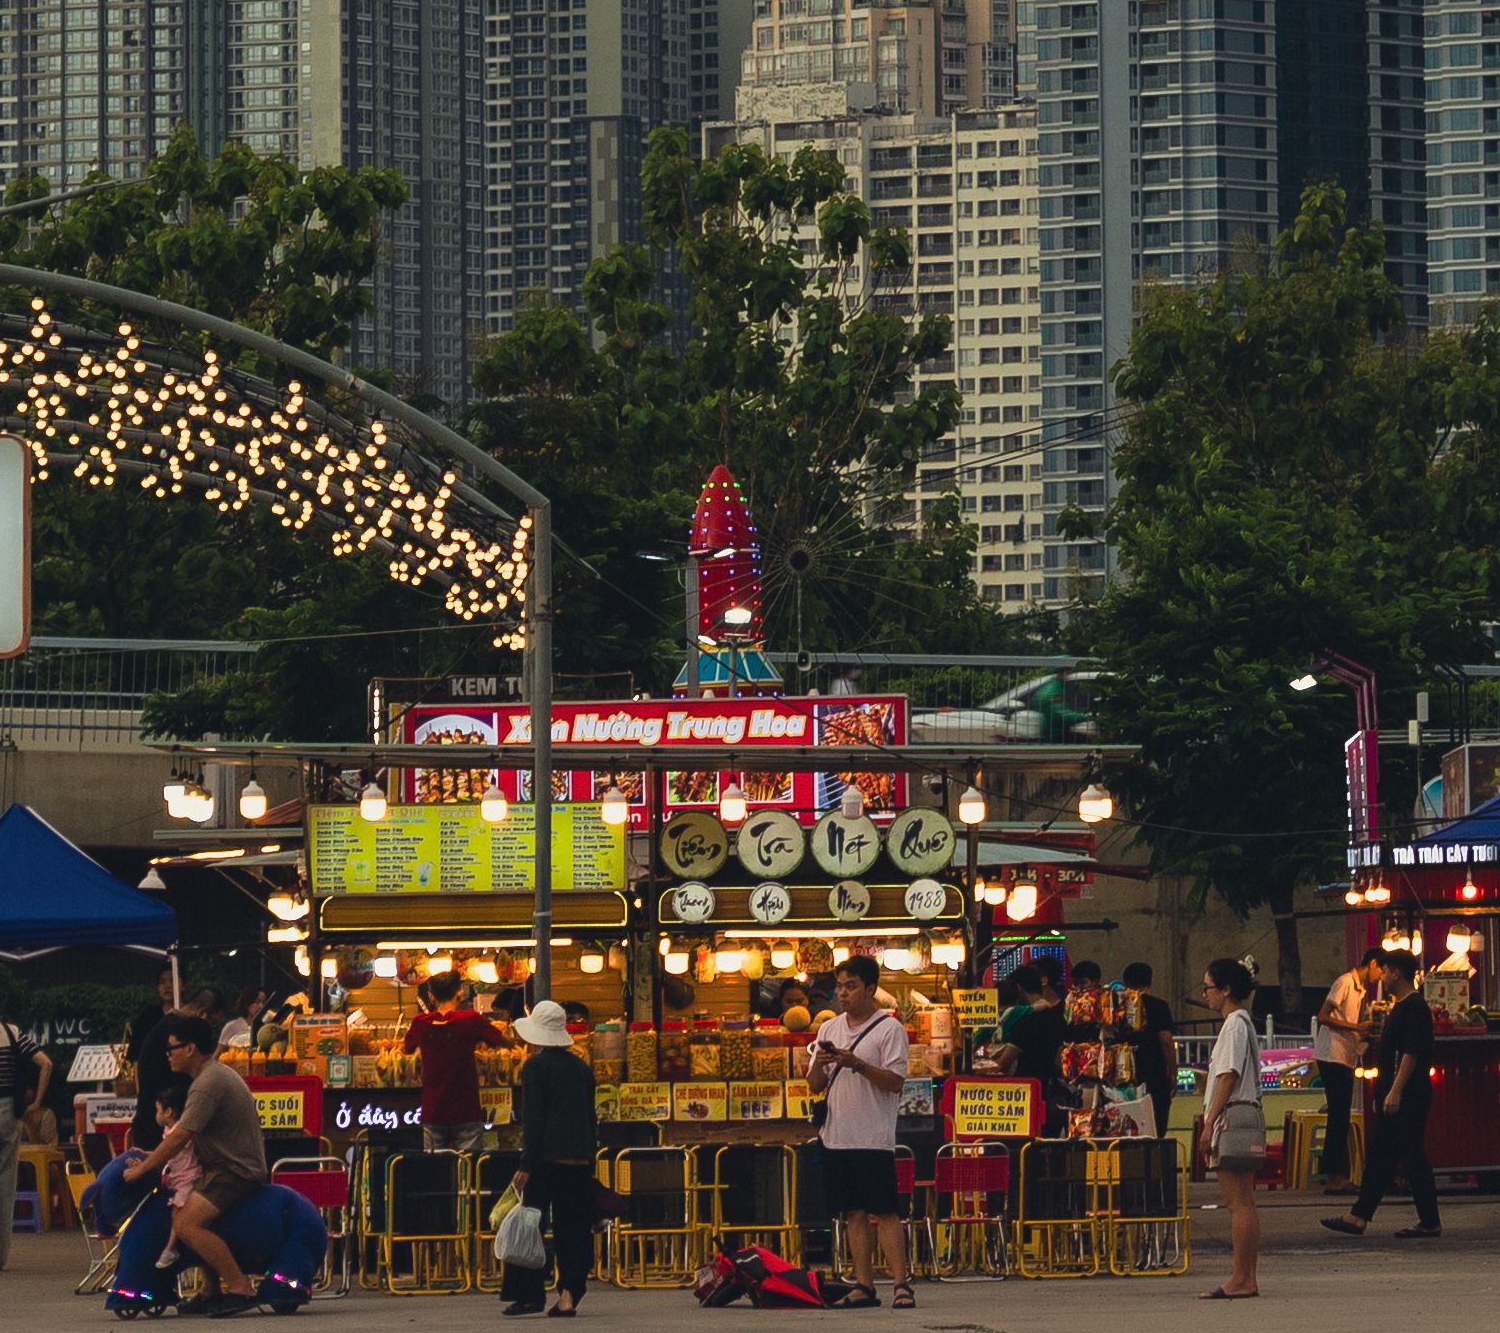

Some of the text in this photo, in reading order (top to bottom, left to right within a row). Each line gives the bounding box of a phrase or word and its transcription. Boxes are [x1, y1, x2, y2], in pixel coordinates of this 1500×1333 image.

[452, 677, 497, 696] KEM
[666, 709, 747, 745] Trung
[748, 709, 807, 738] Hoa
[900, 818, 949, 861] Quê
[1393, 844, 1414, 865] TRÀ
[1418, 843, 1444, 864] TRÁI
[1447, 843, 1468, 863] CÂY
[908, 890, 943, 912] 1988
[54, 1017, 92, 1035] WC
[269, 1094, 299, 1111] SUỐI
[960, 1087, 1027, 1103] NƯỚC SUỐI
[336, 1101, 351, 1129] Ở
[358, 1103, 399, 1130] đây
[960, 1103, 994, 1116] NƯỚC
